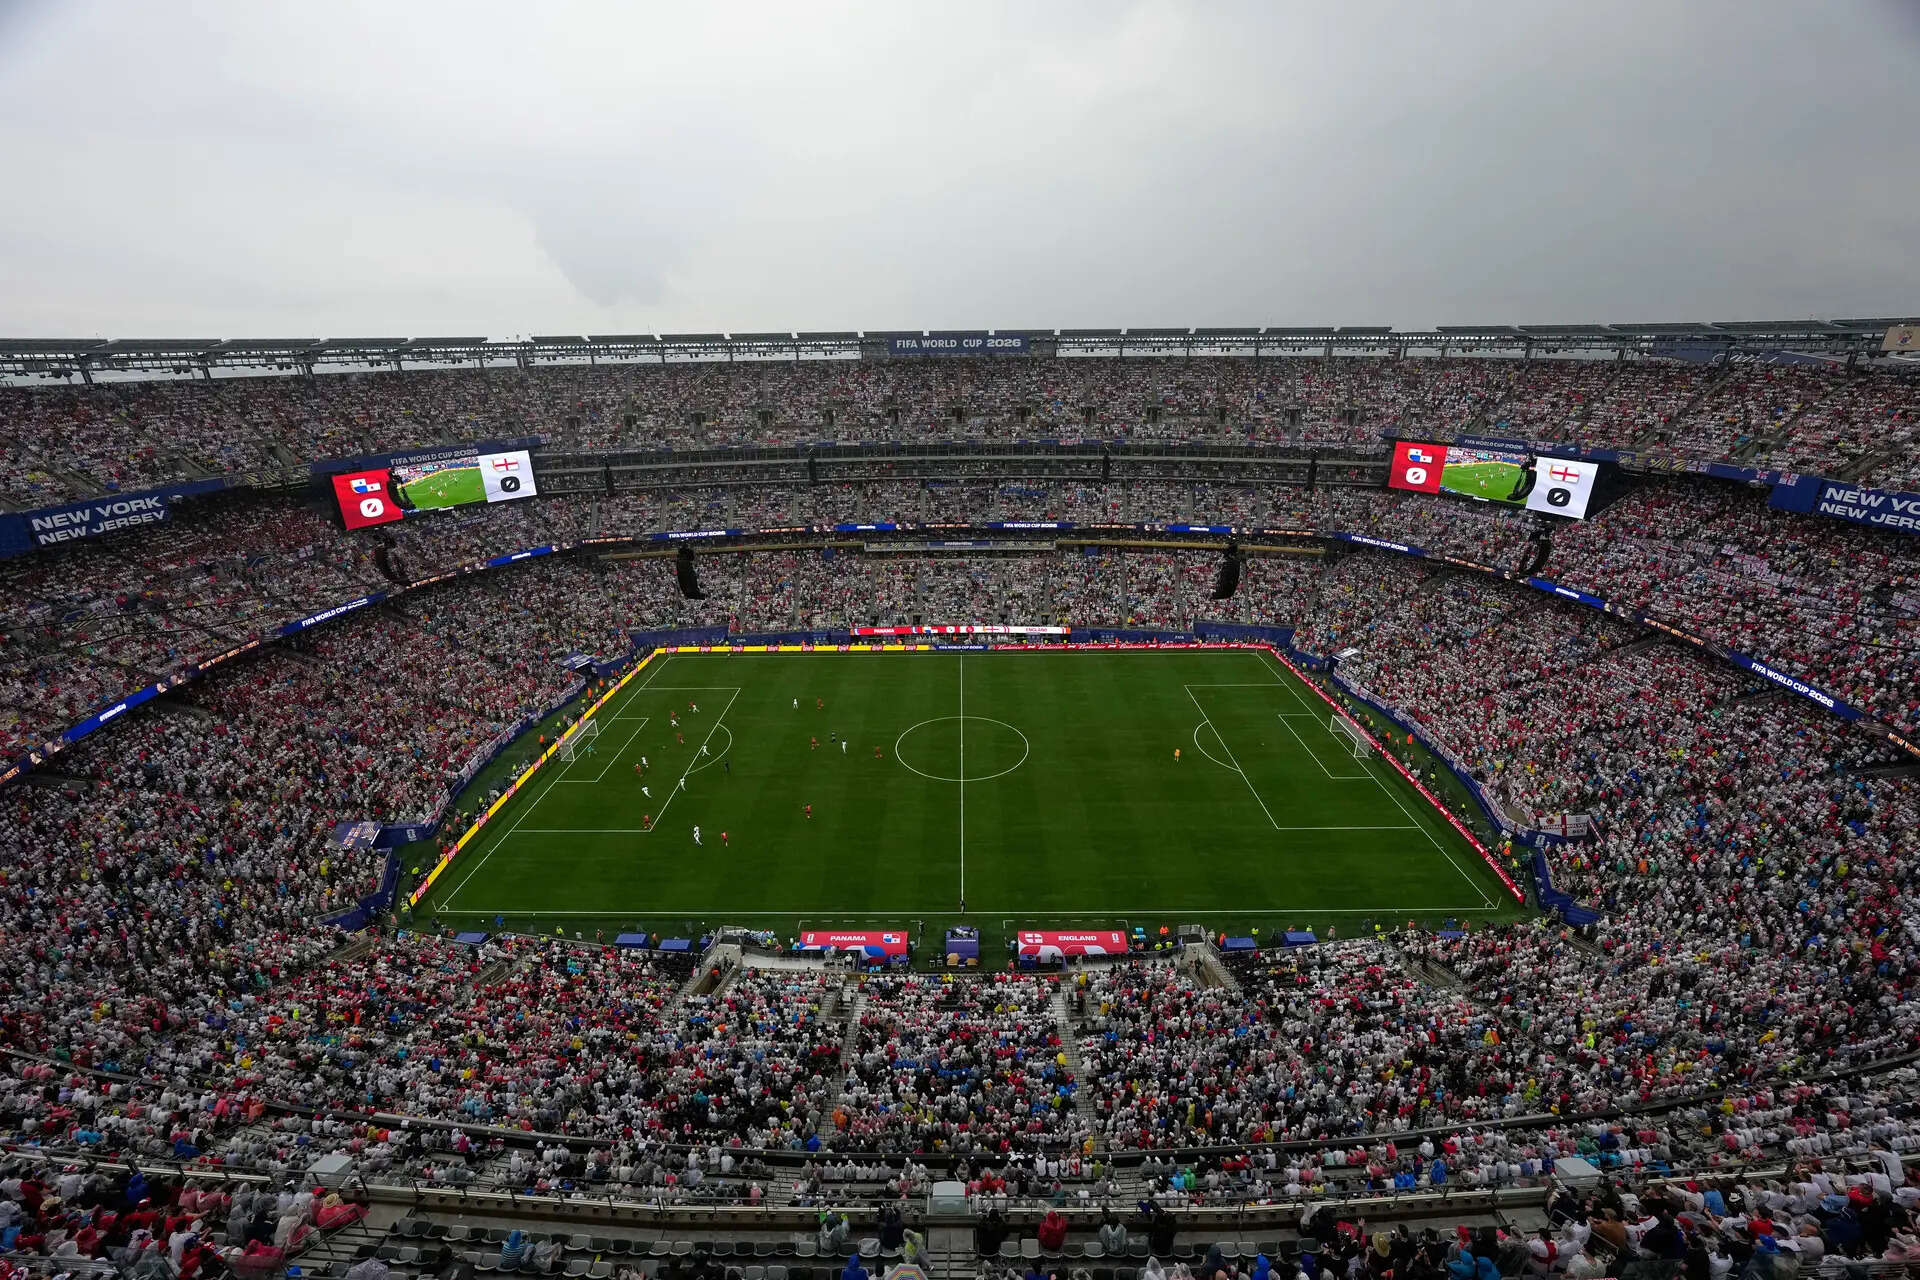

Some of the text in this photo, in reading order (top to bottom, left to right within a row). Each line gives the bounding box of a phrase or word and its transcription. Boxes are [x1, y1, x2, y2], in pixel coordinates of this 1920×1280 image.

[896, 338, 1022, 349] FIFA WORLD CUP 2026
[390, 456, 408, 466] FIFA
[408, 453, 437, 464] WORLD
[437, 451, 453, 460] CUP
[500, 476, 521, 493] 0
[1405, 467, 1427, 485] 0
[1547, 487, 1571, 507] 0
[1824, 487, 1885, 508] NEW
[31, 496, 163, 531] NEW YORK
[359, 497, 385, 518] 0
[1820, 502, 1868, 520] NEW
[38, 510, 165, 545] NEW JERSEY
[301, 617, 316, 628] FIFA
[315, 609, 336, 622] WORLD
[336, 605, 348, 615] CUP
[1751, 662, 1835, 708] FIFA WORLD CUP 2026
